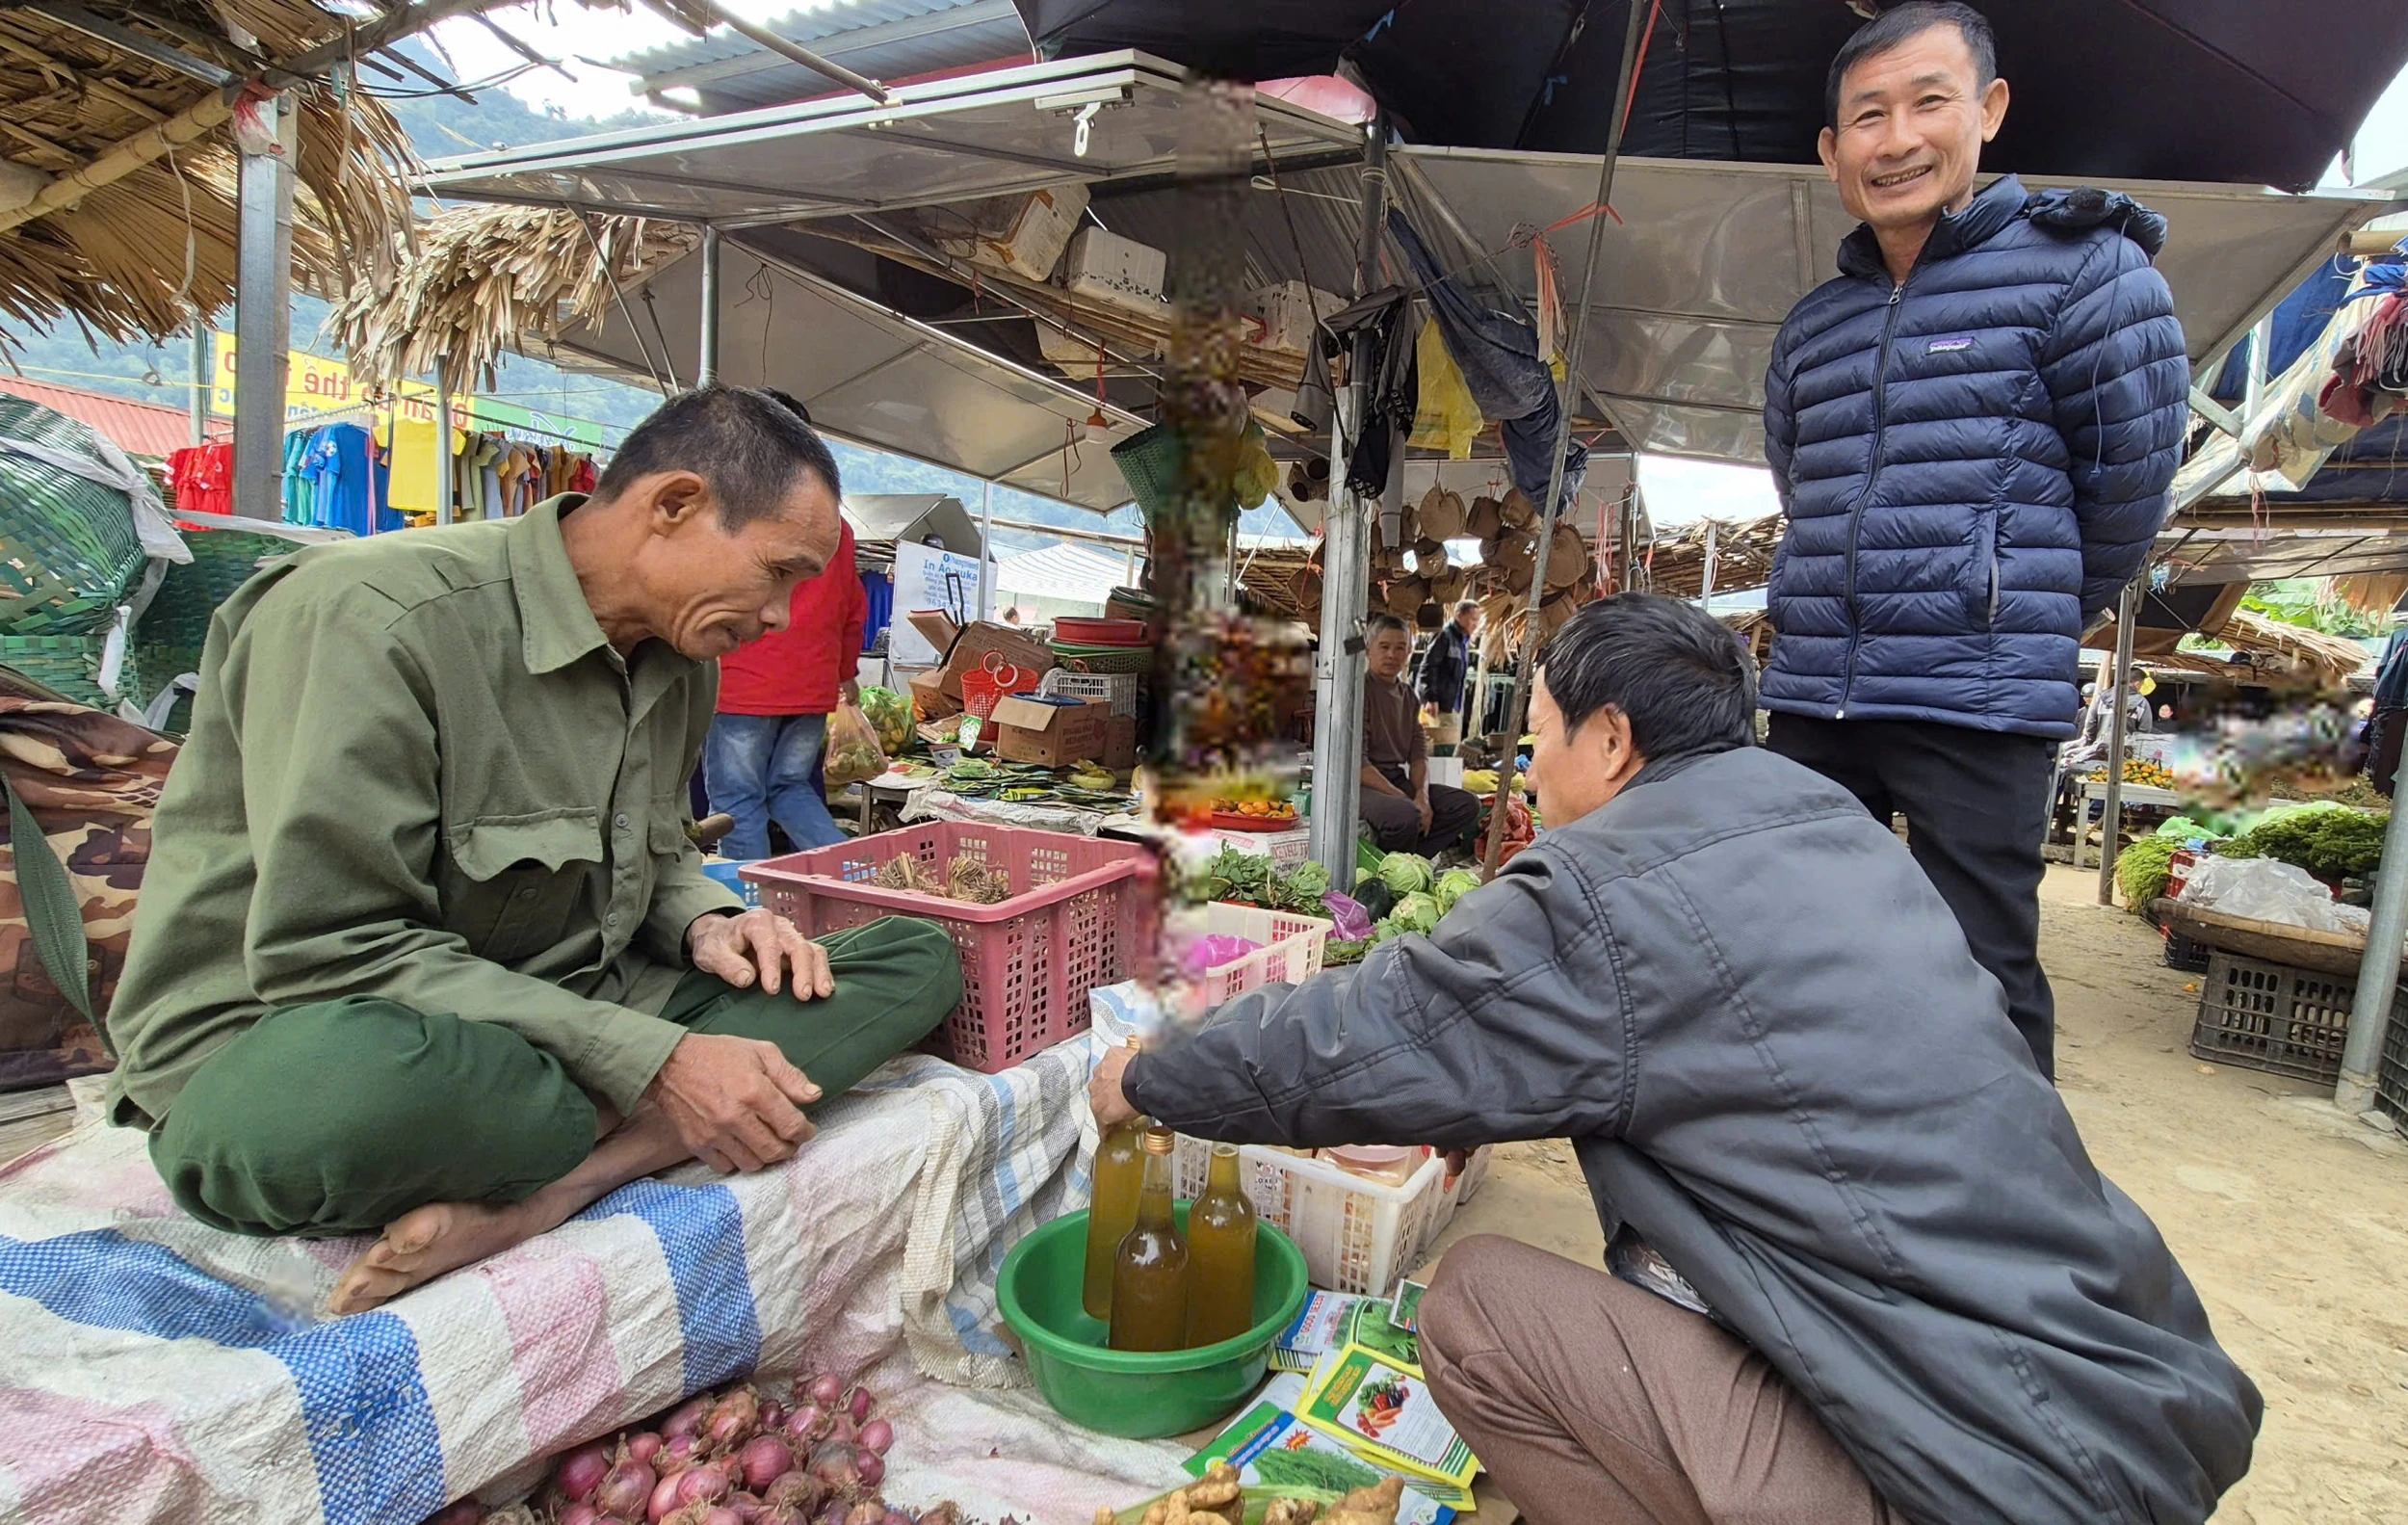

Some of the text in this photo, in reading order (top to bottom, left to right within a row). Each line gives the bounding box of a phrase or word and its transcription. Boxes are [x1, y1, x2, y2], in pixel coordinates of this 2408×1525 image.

[924, 559, 935, 570] In
[1300, 1295, 1325, 1333] GOOD SEEDS
